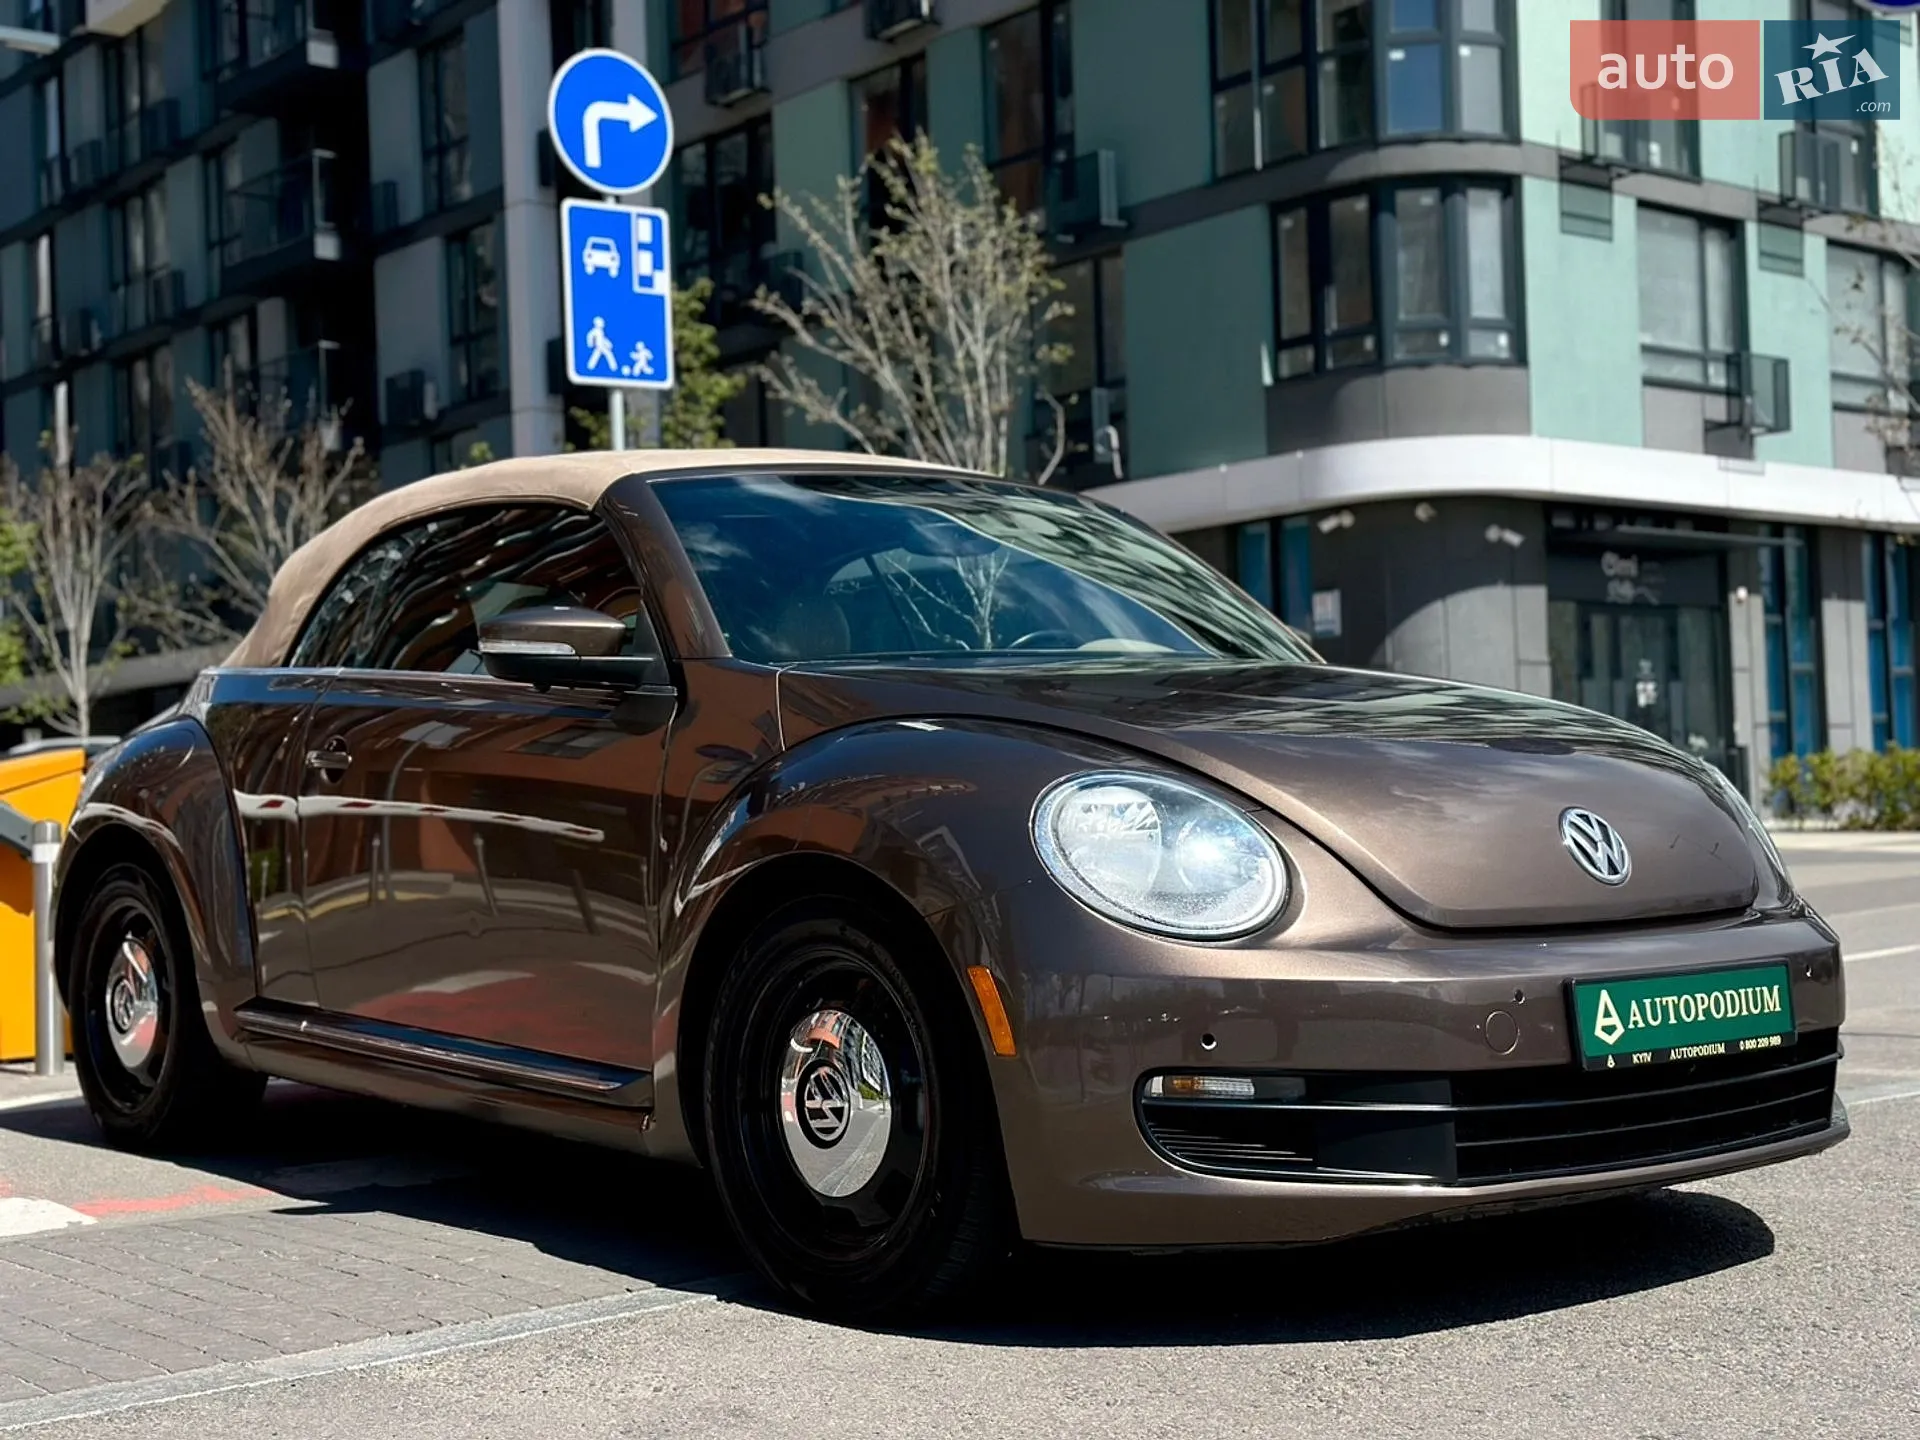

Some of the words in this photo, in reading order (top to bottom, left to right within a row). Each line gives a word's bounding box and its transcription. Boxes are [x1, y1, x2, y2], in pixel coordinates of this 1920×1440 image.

[1627, 984, 1782, 1029] AUTOPODIUM
[1632, 1052, 1652, 1064] KYIV
[1669, 1042, 1726, 1060] AUTOPODIUM
